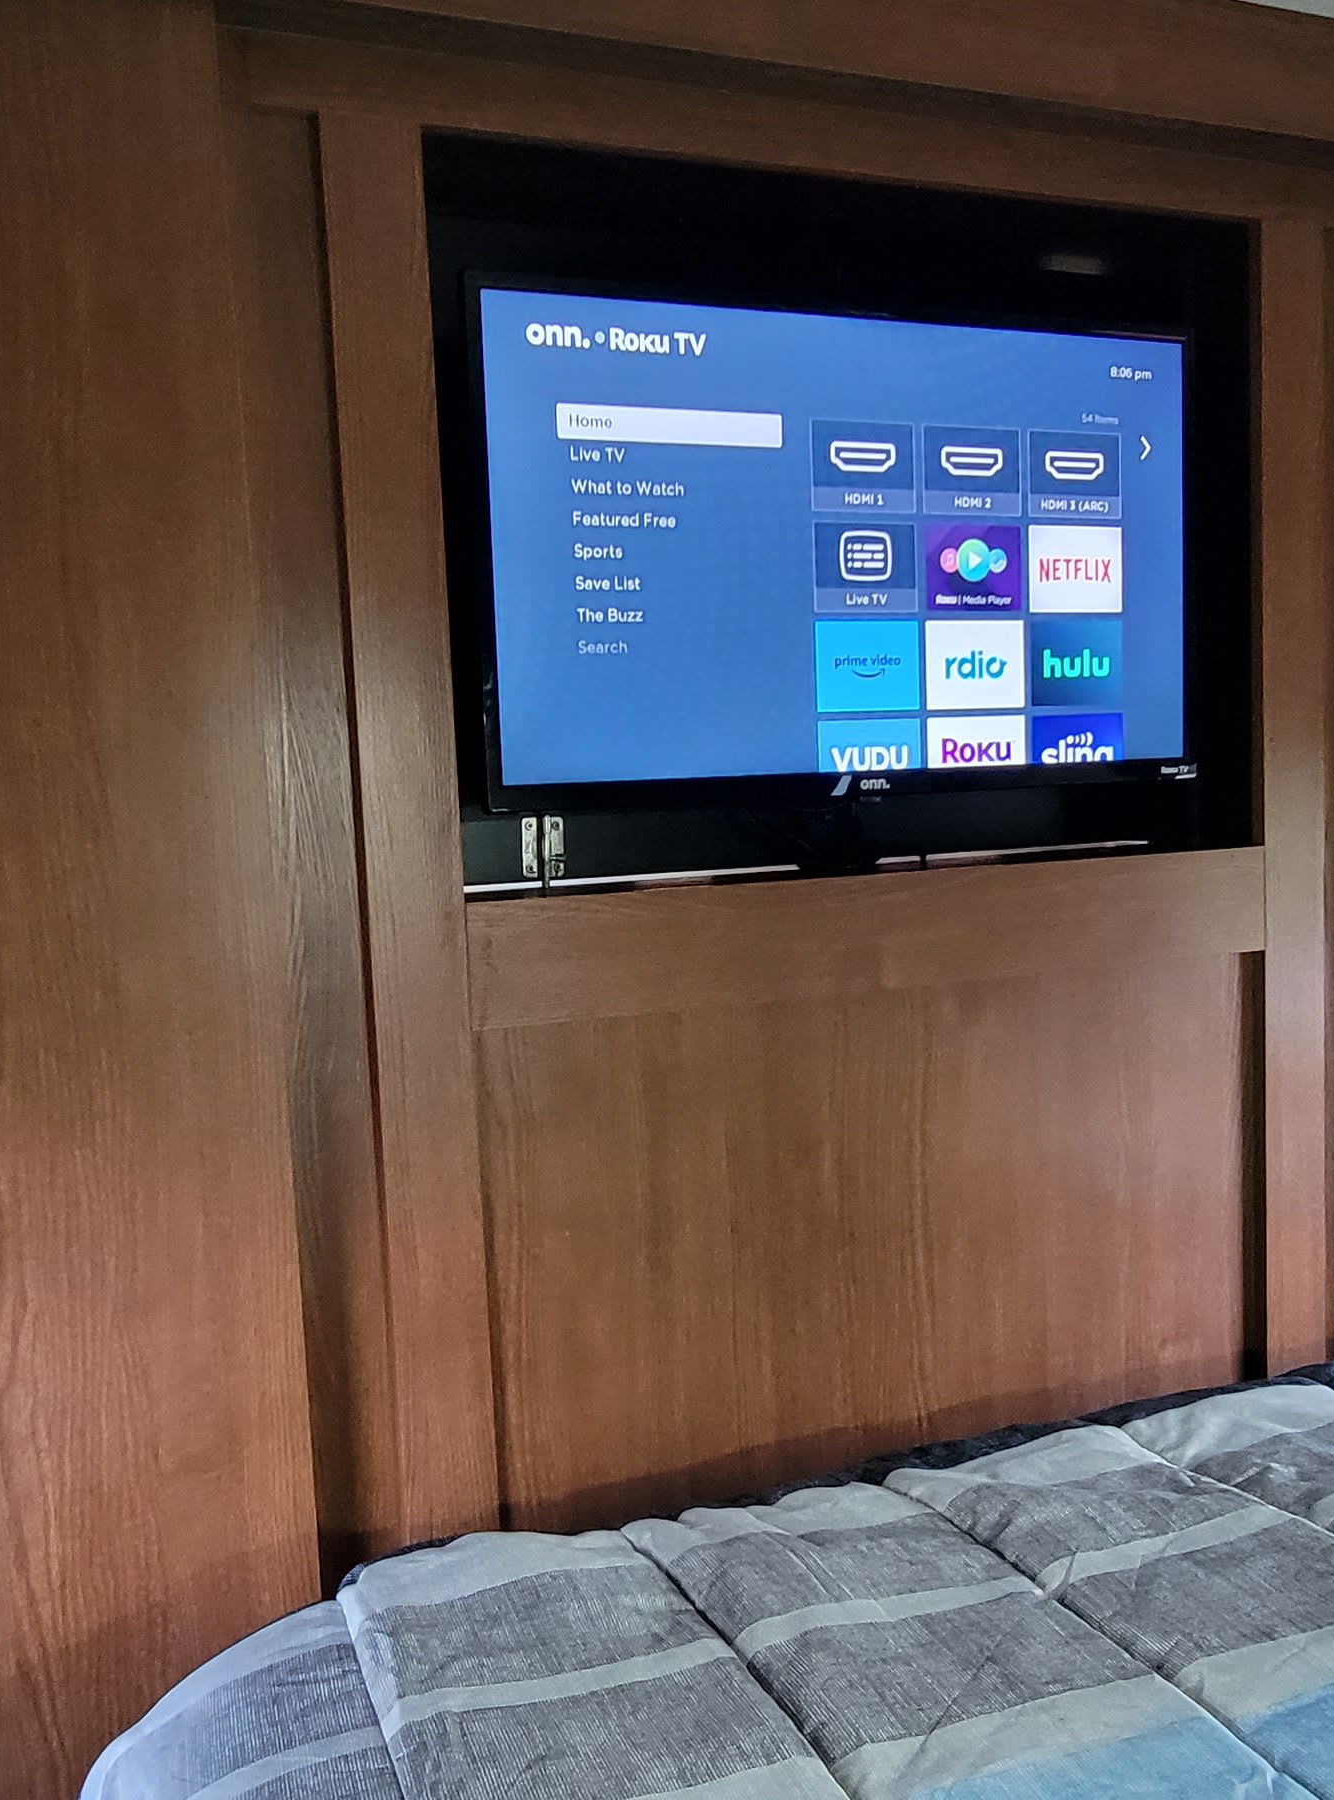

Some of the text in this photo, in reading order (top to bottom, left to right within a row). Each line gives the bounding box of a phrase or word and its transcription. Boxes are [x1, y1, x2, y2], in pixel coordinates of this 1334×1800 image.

[525, 322, 591, 350] onn.
[673, 331, 707, 357] TV
[1134, 369, 1152, 381] pm
[570, 445, 625, 463] Live TV
[571, 478, 685, 497] What to Watch
[844, 492, 884, 506] HDMI 1
[954, 496, 992, 509] HDMI 2
[1041, 499, 1067, 511] HDMI
[1078, 500, 1109, 513] (ARC)
[572, 511, 676, 528] Featured Free
[574, 543, 623, 560] Sports
[1038, 558, 1112, 583] NETFLIX
[575, 576, 641, 591] Save List
[845, 593, 888, 606] Live TV
[576, 608, 644, 623] The Buzz
[578, 640, 628, 654] Search
[834, 653, 901, 670] prime video
[944, 651, 1007, 680] rdio
[1042, 649, 1111, 679] hulu
[860, 778, 890, 790] onn.
